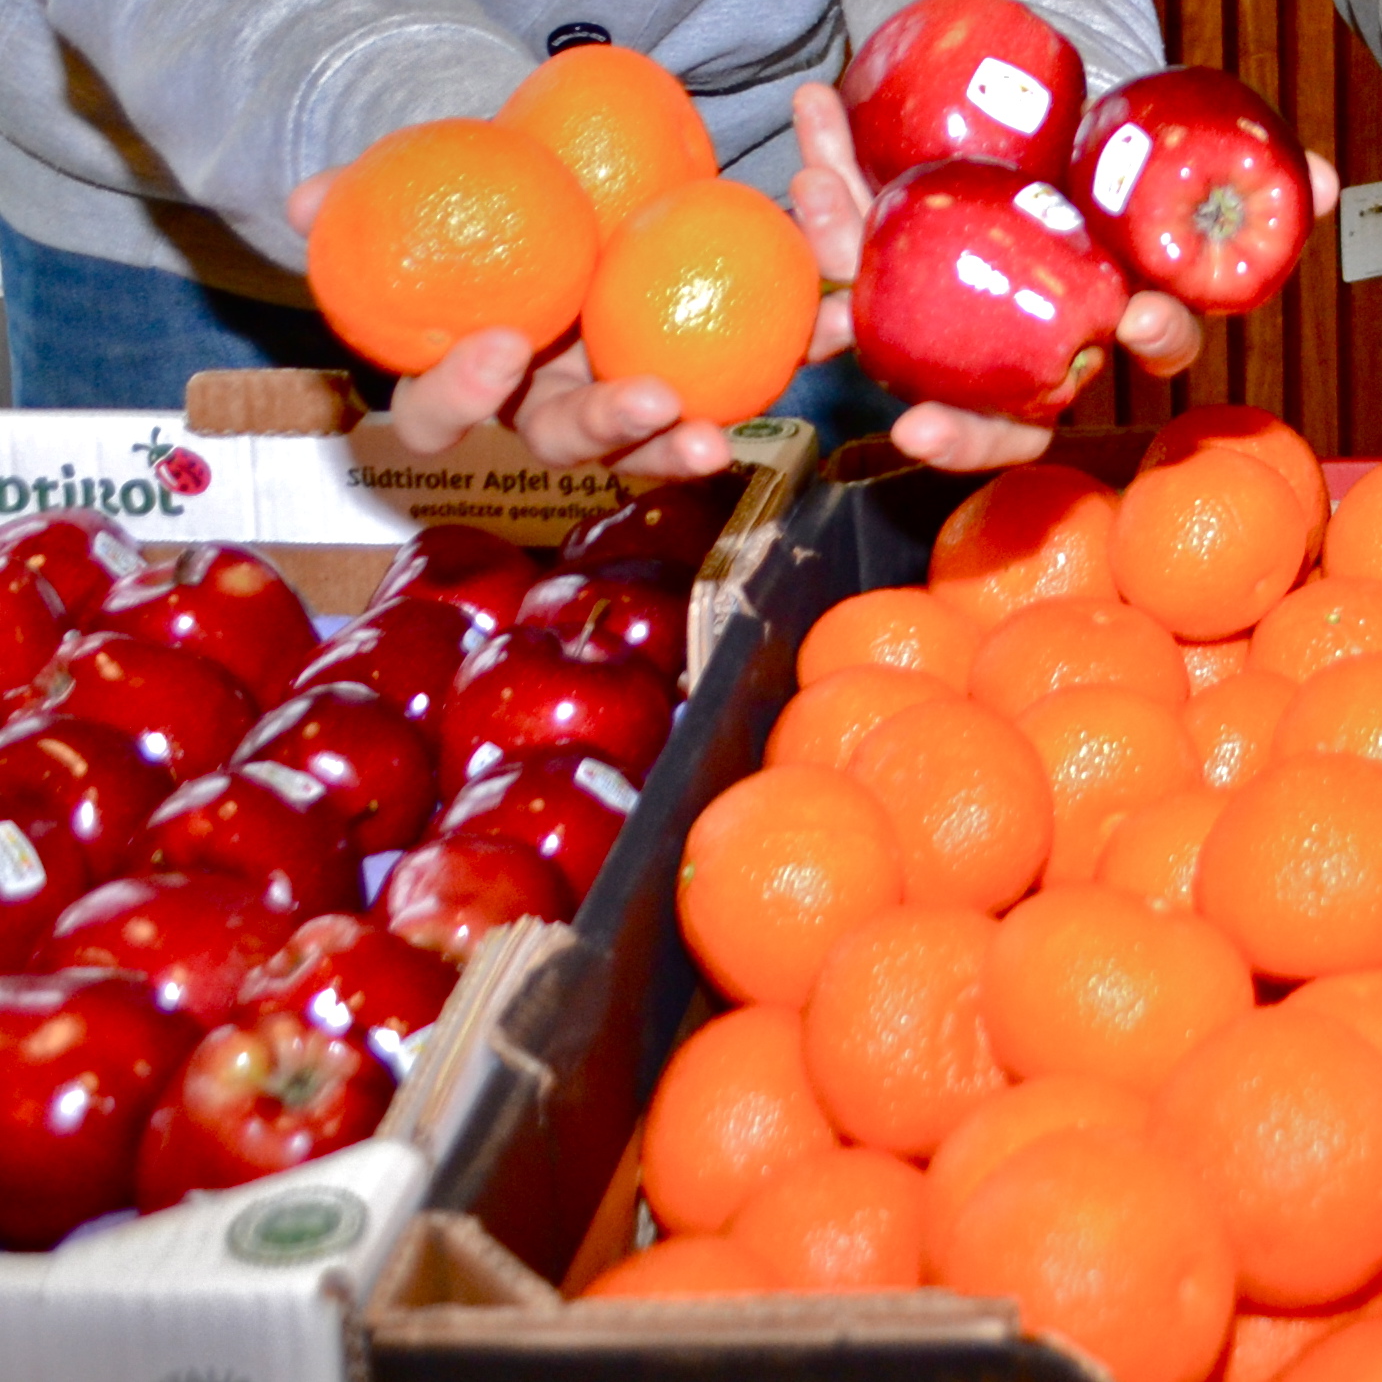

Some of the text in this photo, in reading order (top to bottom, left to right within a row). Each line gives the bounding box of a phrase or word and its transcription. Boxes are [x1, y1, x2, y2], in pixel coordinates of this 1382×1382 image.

[346, 466, 474, 490] Südtiroler
[482, 469, 549, 494] Apfel
[409, 502, 503, 519] geschützte
